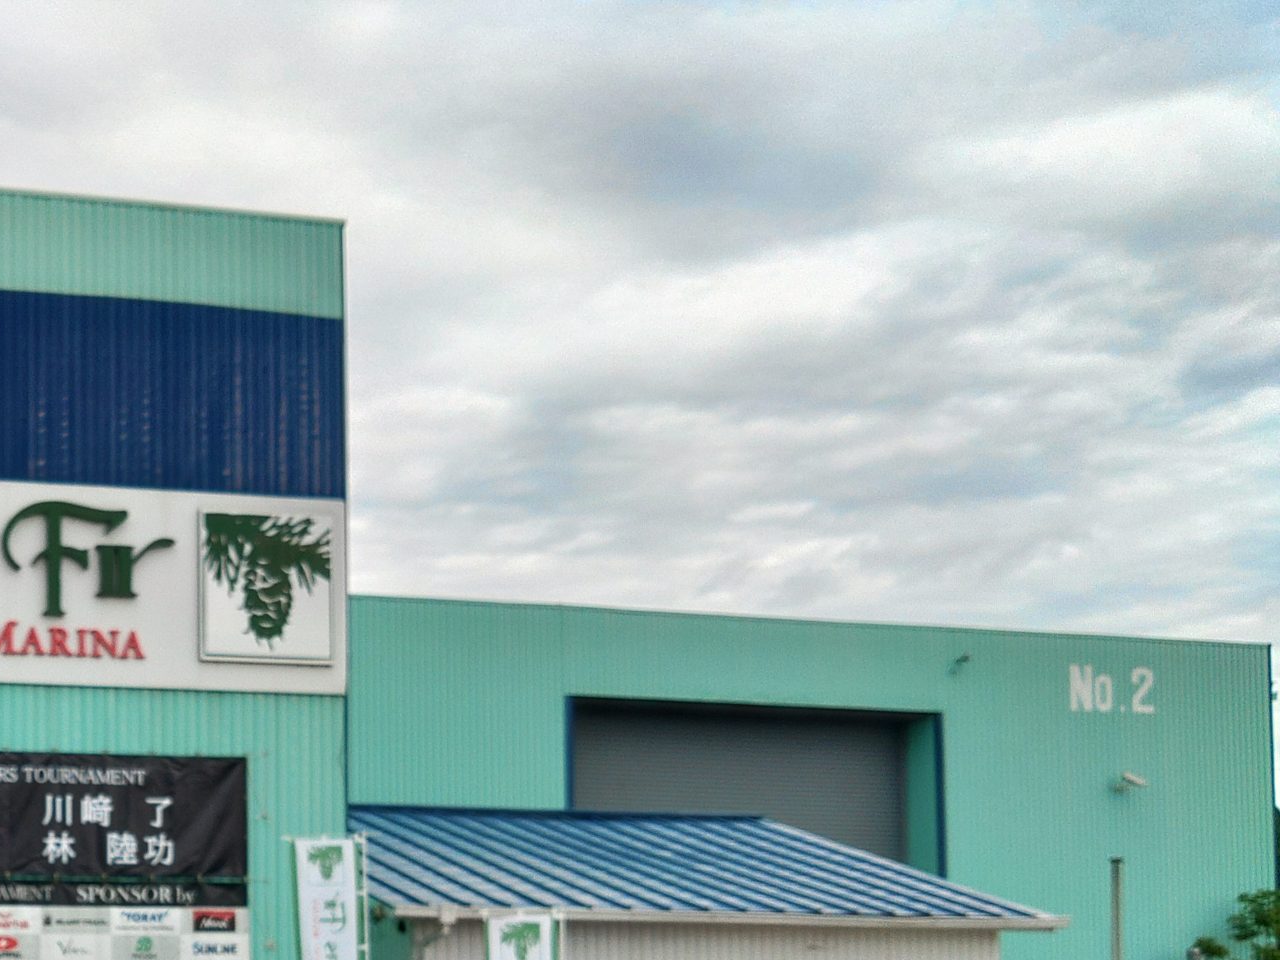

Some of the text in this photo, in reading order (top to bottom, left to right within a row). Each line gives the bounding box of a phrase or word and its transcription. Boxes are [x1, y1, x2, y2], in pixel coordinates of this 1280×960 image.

[0, 500, 176, 617] Fir
[1069, 664, 1156, 714] No.2
[22, 766, 147, 786] TOURNAMENT
[76, 883, 170, 904] SPONSOR
[176, 884, 196, 905] by
